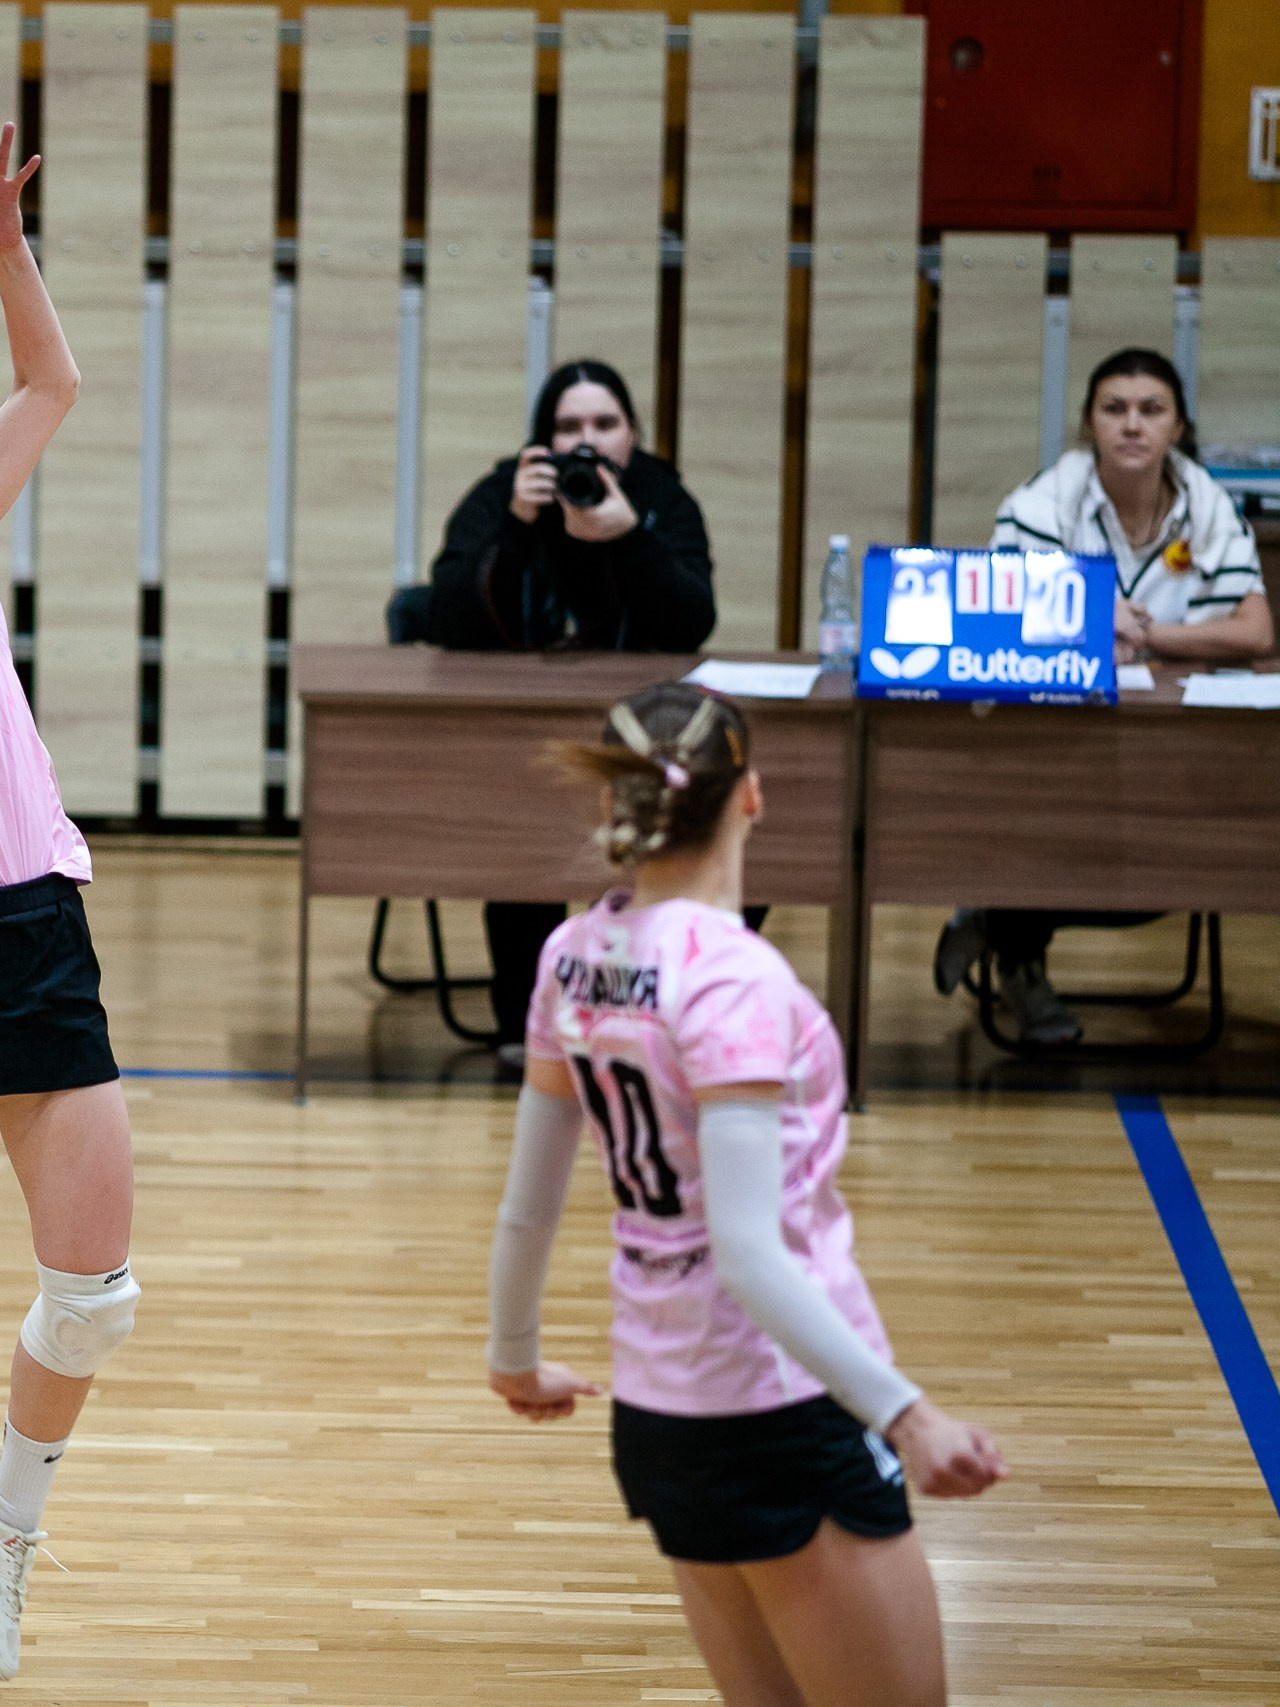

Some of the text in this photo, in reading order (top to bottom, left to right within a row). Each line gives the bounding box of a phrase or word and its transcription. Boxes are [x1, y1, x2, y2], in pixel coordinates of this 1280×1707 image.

[967, 569, 979, 607] 1
[1004, 570, 1014, 606] 1
[1025, 568, 1087, 638] 20
[948, 646, 1100, 689] Butterfly
[570, 1053, 683, 1219] 10
